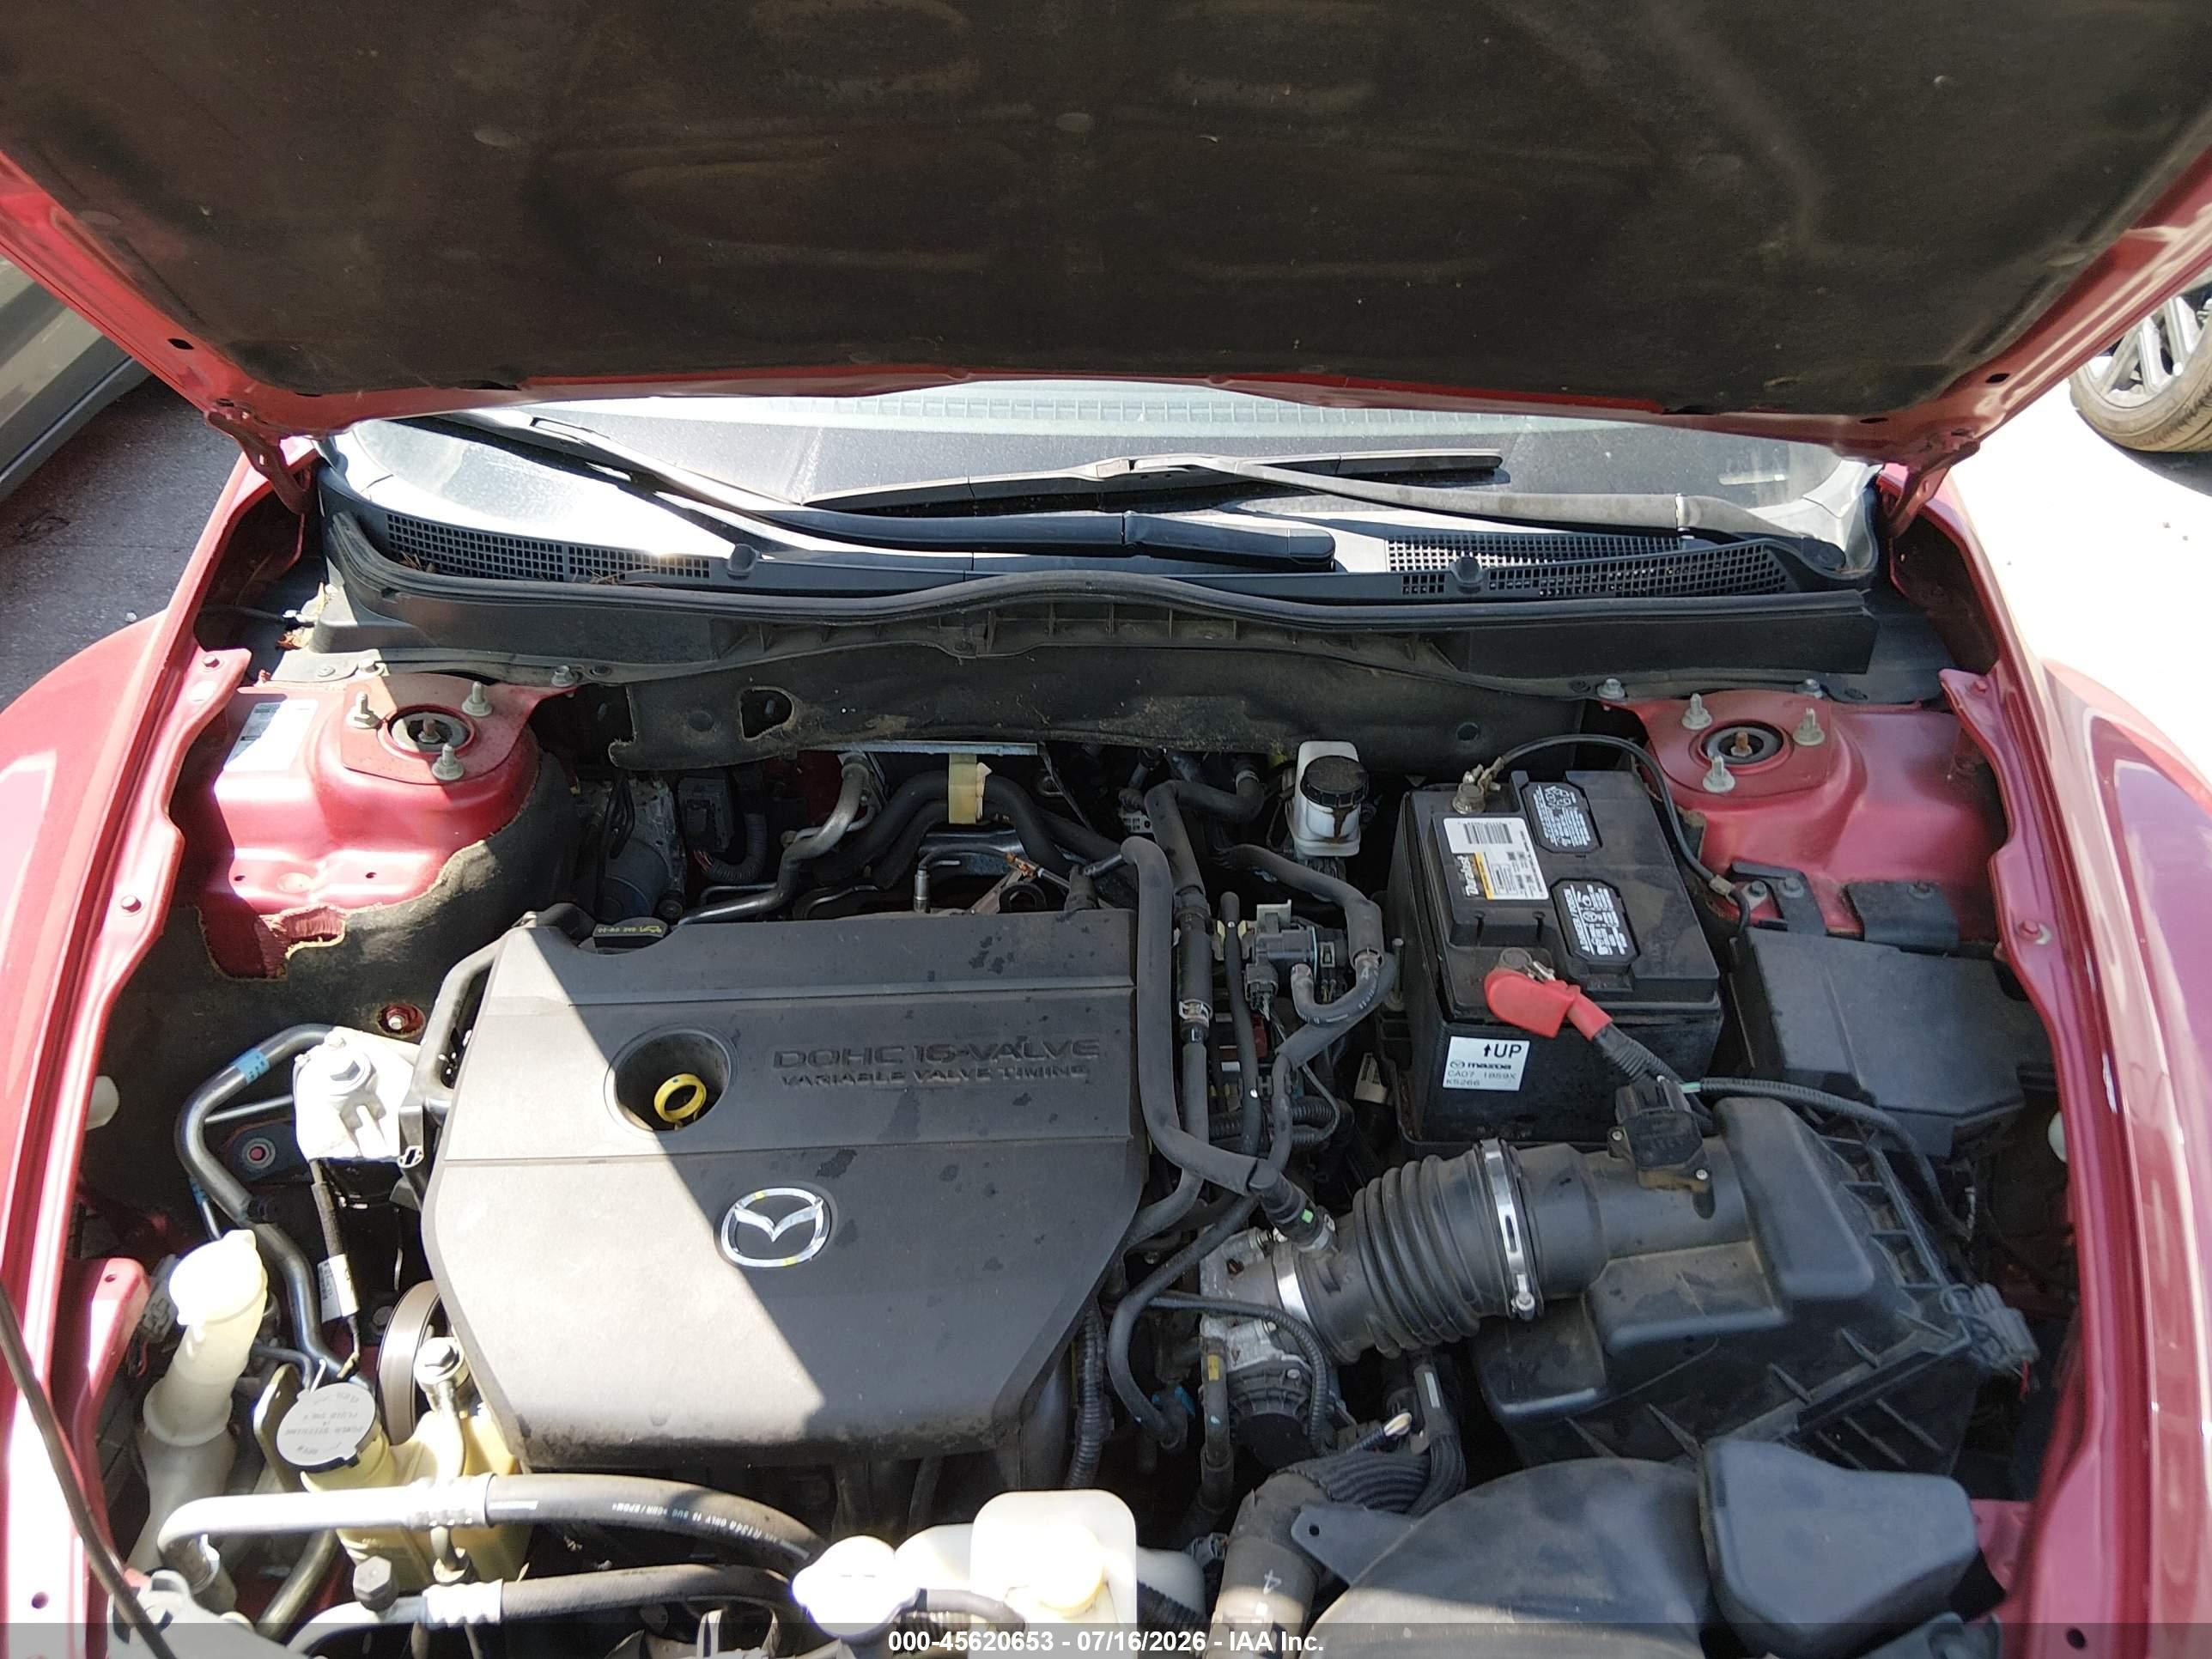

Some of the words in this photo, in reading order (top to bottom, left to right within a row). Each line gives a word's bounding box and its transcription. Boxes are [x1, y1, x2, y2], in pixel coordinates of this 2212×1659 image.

[1456, 854, 1480, 896] Duralast
[773, 1046, 905, 1068] DOHC
[914, 1038, 1100, 1063] 16-VALVE
[1493, 1043, 1522, 1058] UP
[781, 1071, 907, 1086] VARIABLE
[913, 1067, 991, 1083] VALVE
[999, 1064, 1087, 1080] TIMING
